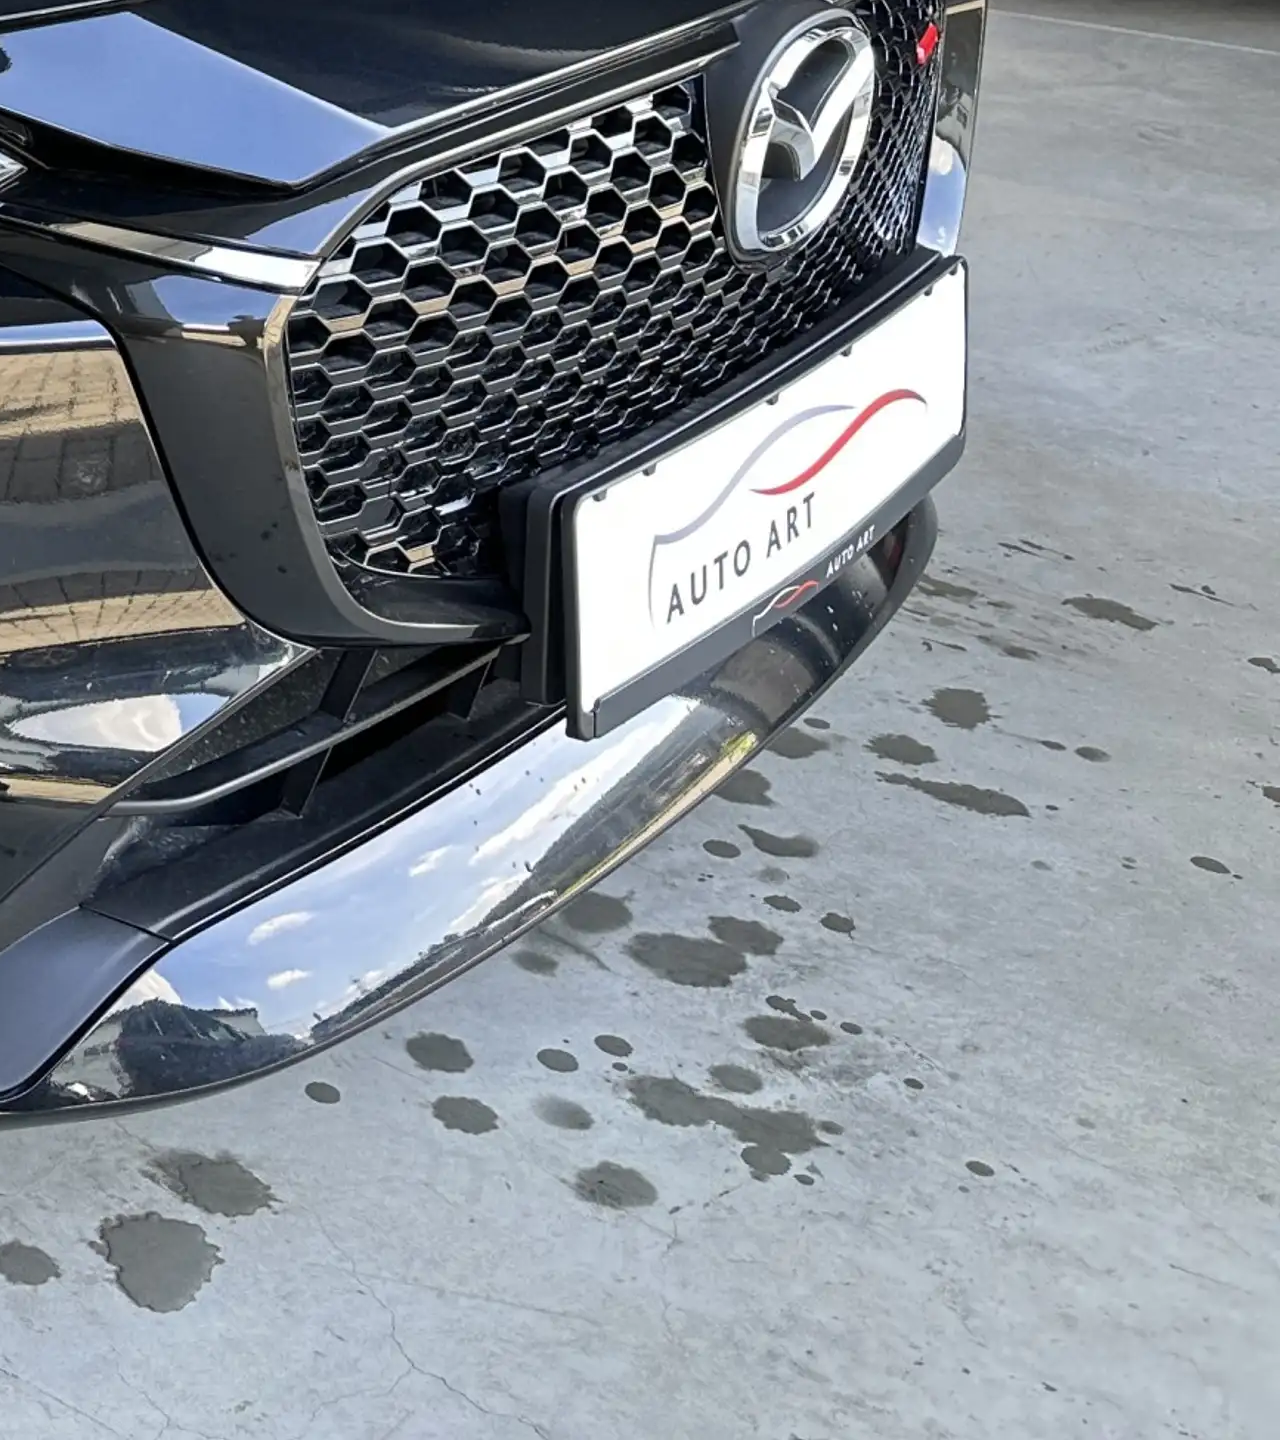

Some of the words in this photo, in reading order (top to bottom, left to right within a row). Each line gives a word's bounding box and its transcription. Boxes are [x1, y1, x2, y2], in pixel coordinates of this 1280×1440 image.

[666, 540, 751, 623] AUTO
[766, 492, 815, 557] ART
[826, 544, 855, 578] AUTO
[856, 524, 875, 552] ART
